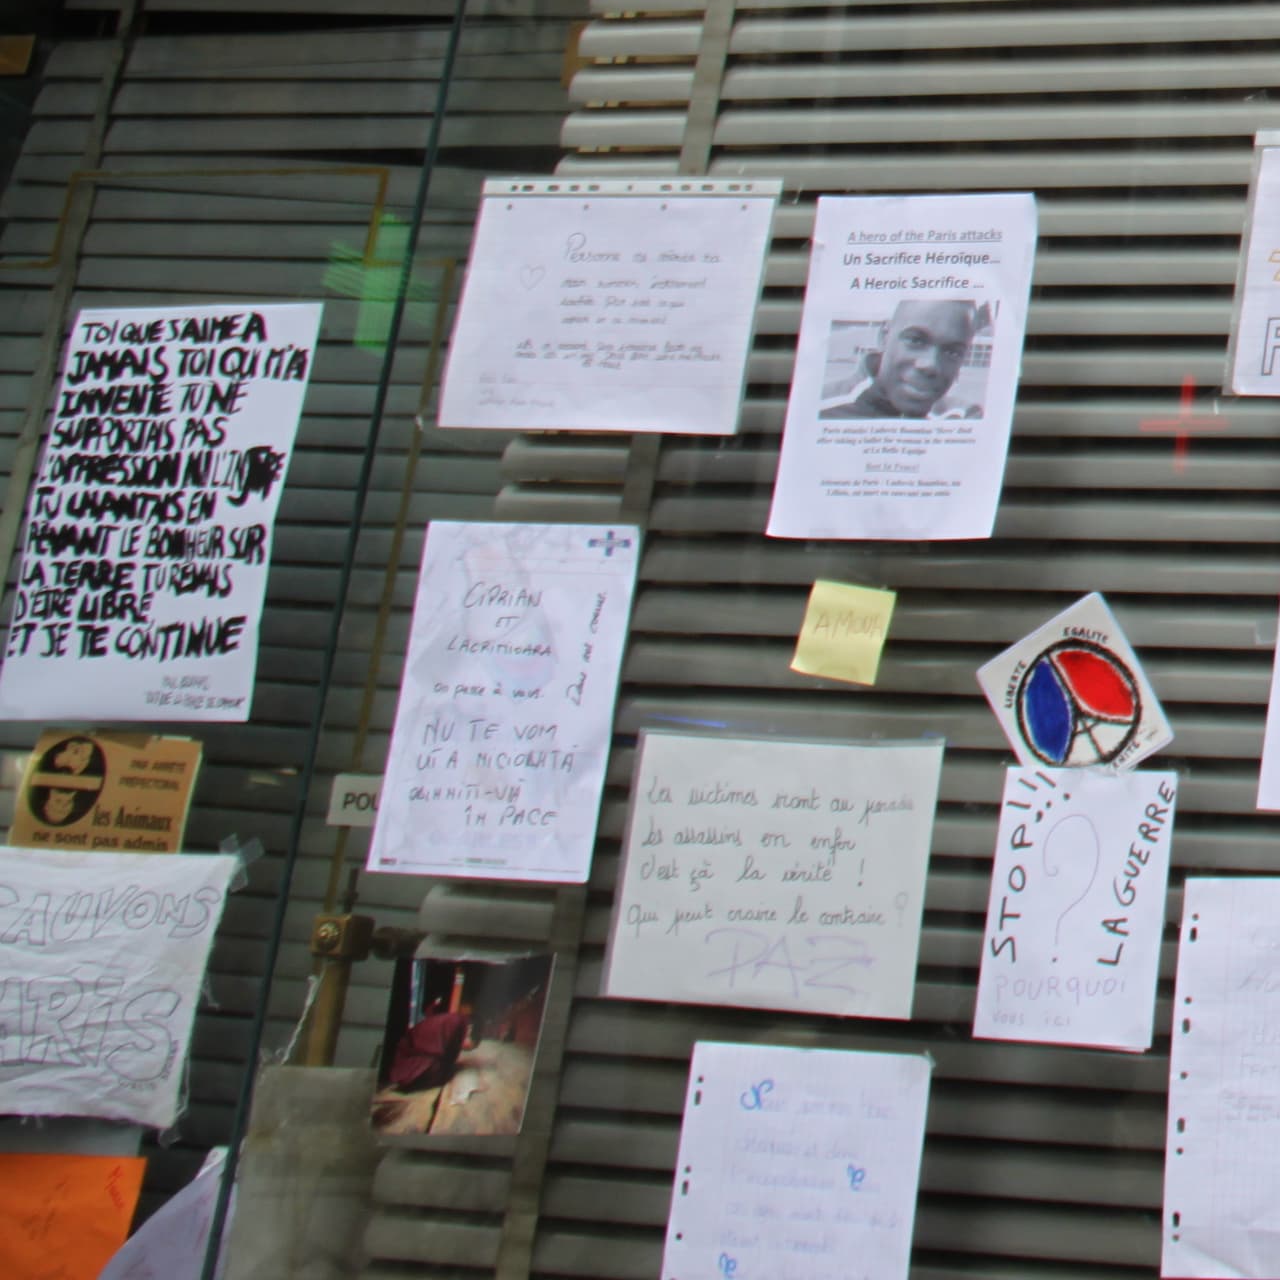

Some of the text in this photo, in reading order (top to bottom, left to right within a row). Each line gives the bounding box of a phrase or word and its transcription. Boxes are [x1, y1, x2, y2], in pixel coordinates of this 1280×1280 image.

[860, 230, 886, 243] hero
[890, 229, 902, 242] of
[905, 229, 924, 242] the
[928, 229, 957, 242] Paris
[960, 228, 1002, 241] attacks
[843, 253, 861, 266] Un
[865, 252, 921, 266] Sacrifice
[850, 275, 969, 290] A Heroic Sacrifice
[82, 321, 117, 344] TOI
[120, 319, 165, 345] QUE
[66, 346, 261, 385] JAMAIS TOI QUI
[180, 381, 205, 413] TU
[204, 379, 250, 416] NE
[179, 415, 230, 451] PAS
[33, 486, 63, 519] TU
[186, 488, 217, 524] EN
[119, 523, 144, 558] LE
[227, 522, 268, 565] SUR
[21, 559, 167, 593] LA TERRE TU
[78, 591, 155, 623] LIBRE
[463, 581, 544, 609] CIPRIAN
[5, 614, 248, 664] ET JE TE CONTINUE
[422, 717, 559, 746] NU TE VOM
[687, 780, 760, 808] victimes
[113, 805, 175, 832] Animaux
[497, 804, 560, 828] PACE
[32, 830, 50, 844] ne
[53, 830, 90, 846] sont
[91, 834, 120, 851] pas
[760, 829, 793, 850] en
[1112, 779, 1177, 909] GUERRE
[735, 853, 769, 884] la
[665, 903, 714, 938] peut
[786, 893, 811, 926] le
[1096, 915, 1132, 969] LA
